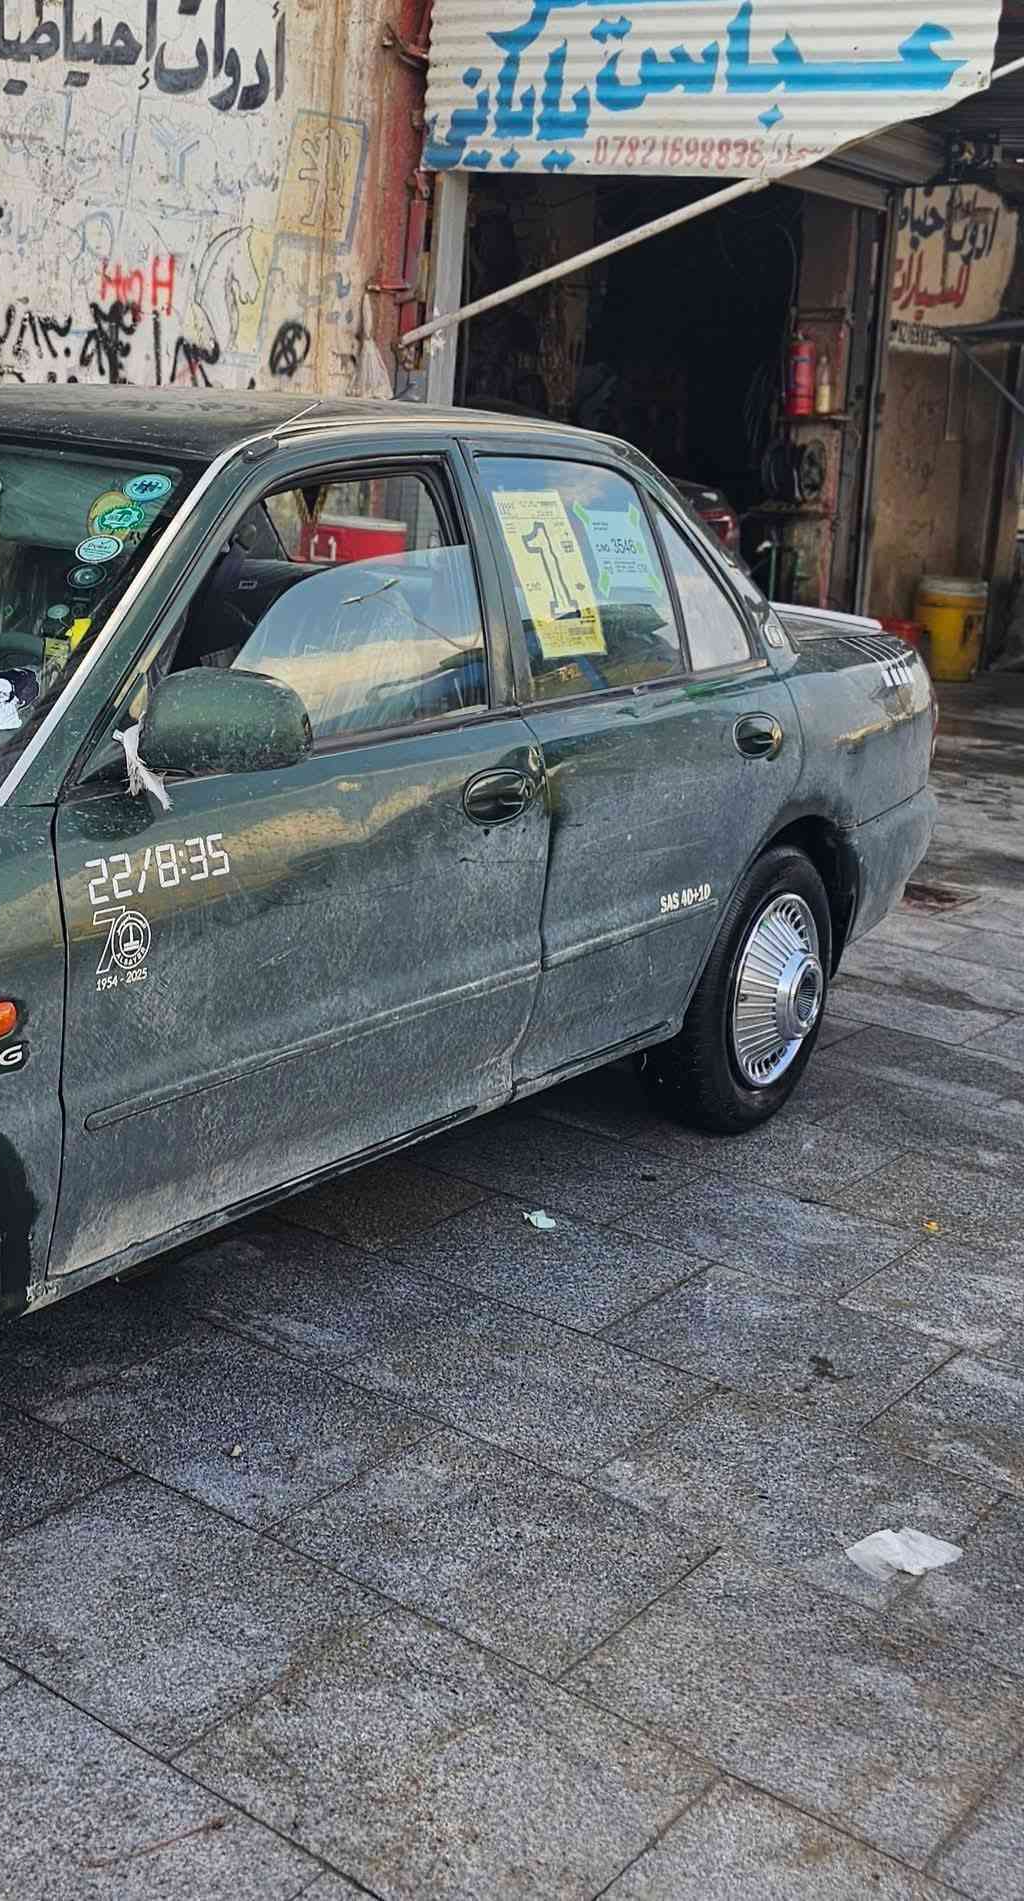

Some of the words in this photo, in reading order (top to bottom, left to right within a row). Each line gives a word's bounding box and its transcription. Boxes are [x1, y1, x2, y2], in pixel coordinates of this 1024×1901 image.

[84, 832, 231, 905] 22/8:35
[660, 891, 680, 913] SAS
[95, 975, 118, 992] 1954
[125, 967, 148, 984] 2025
